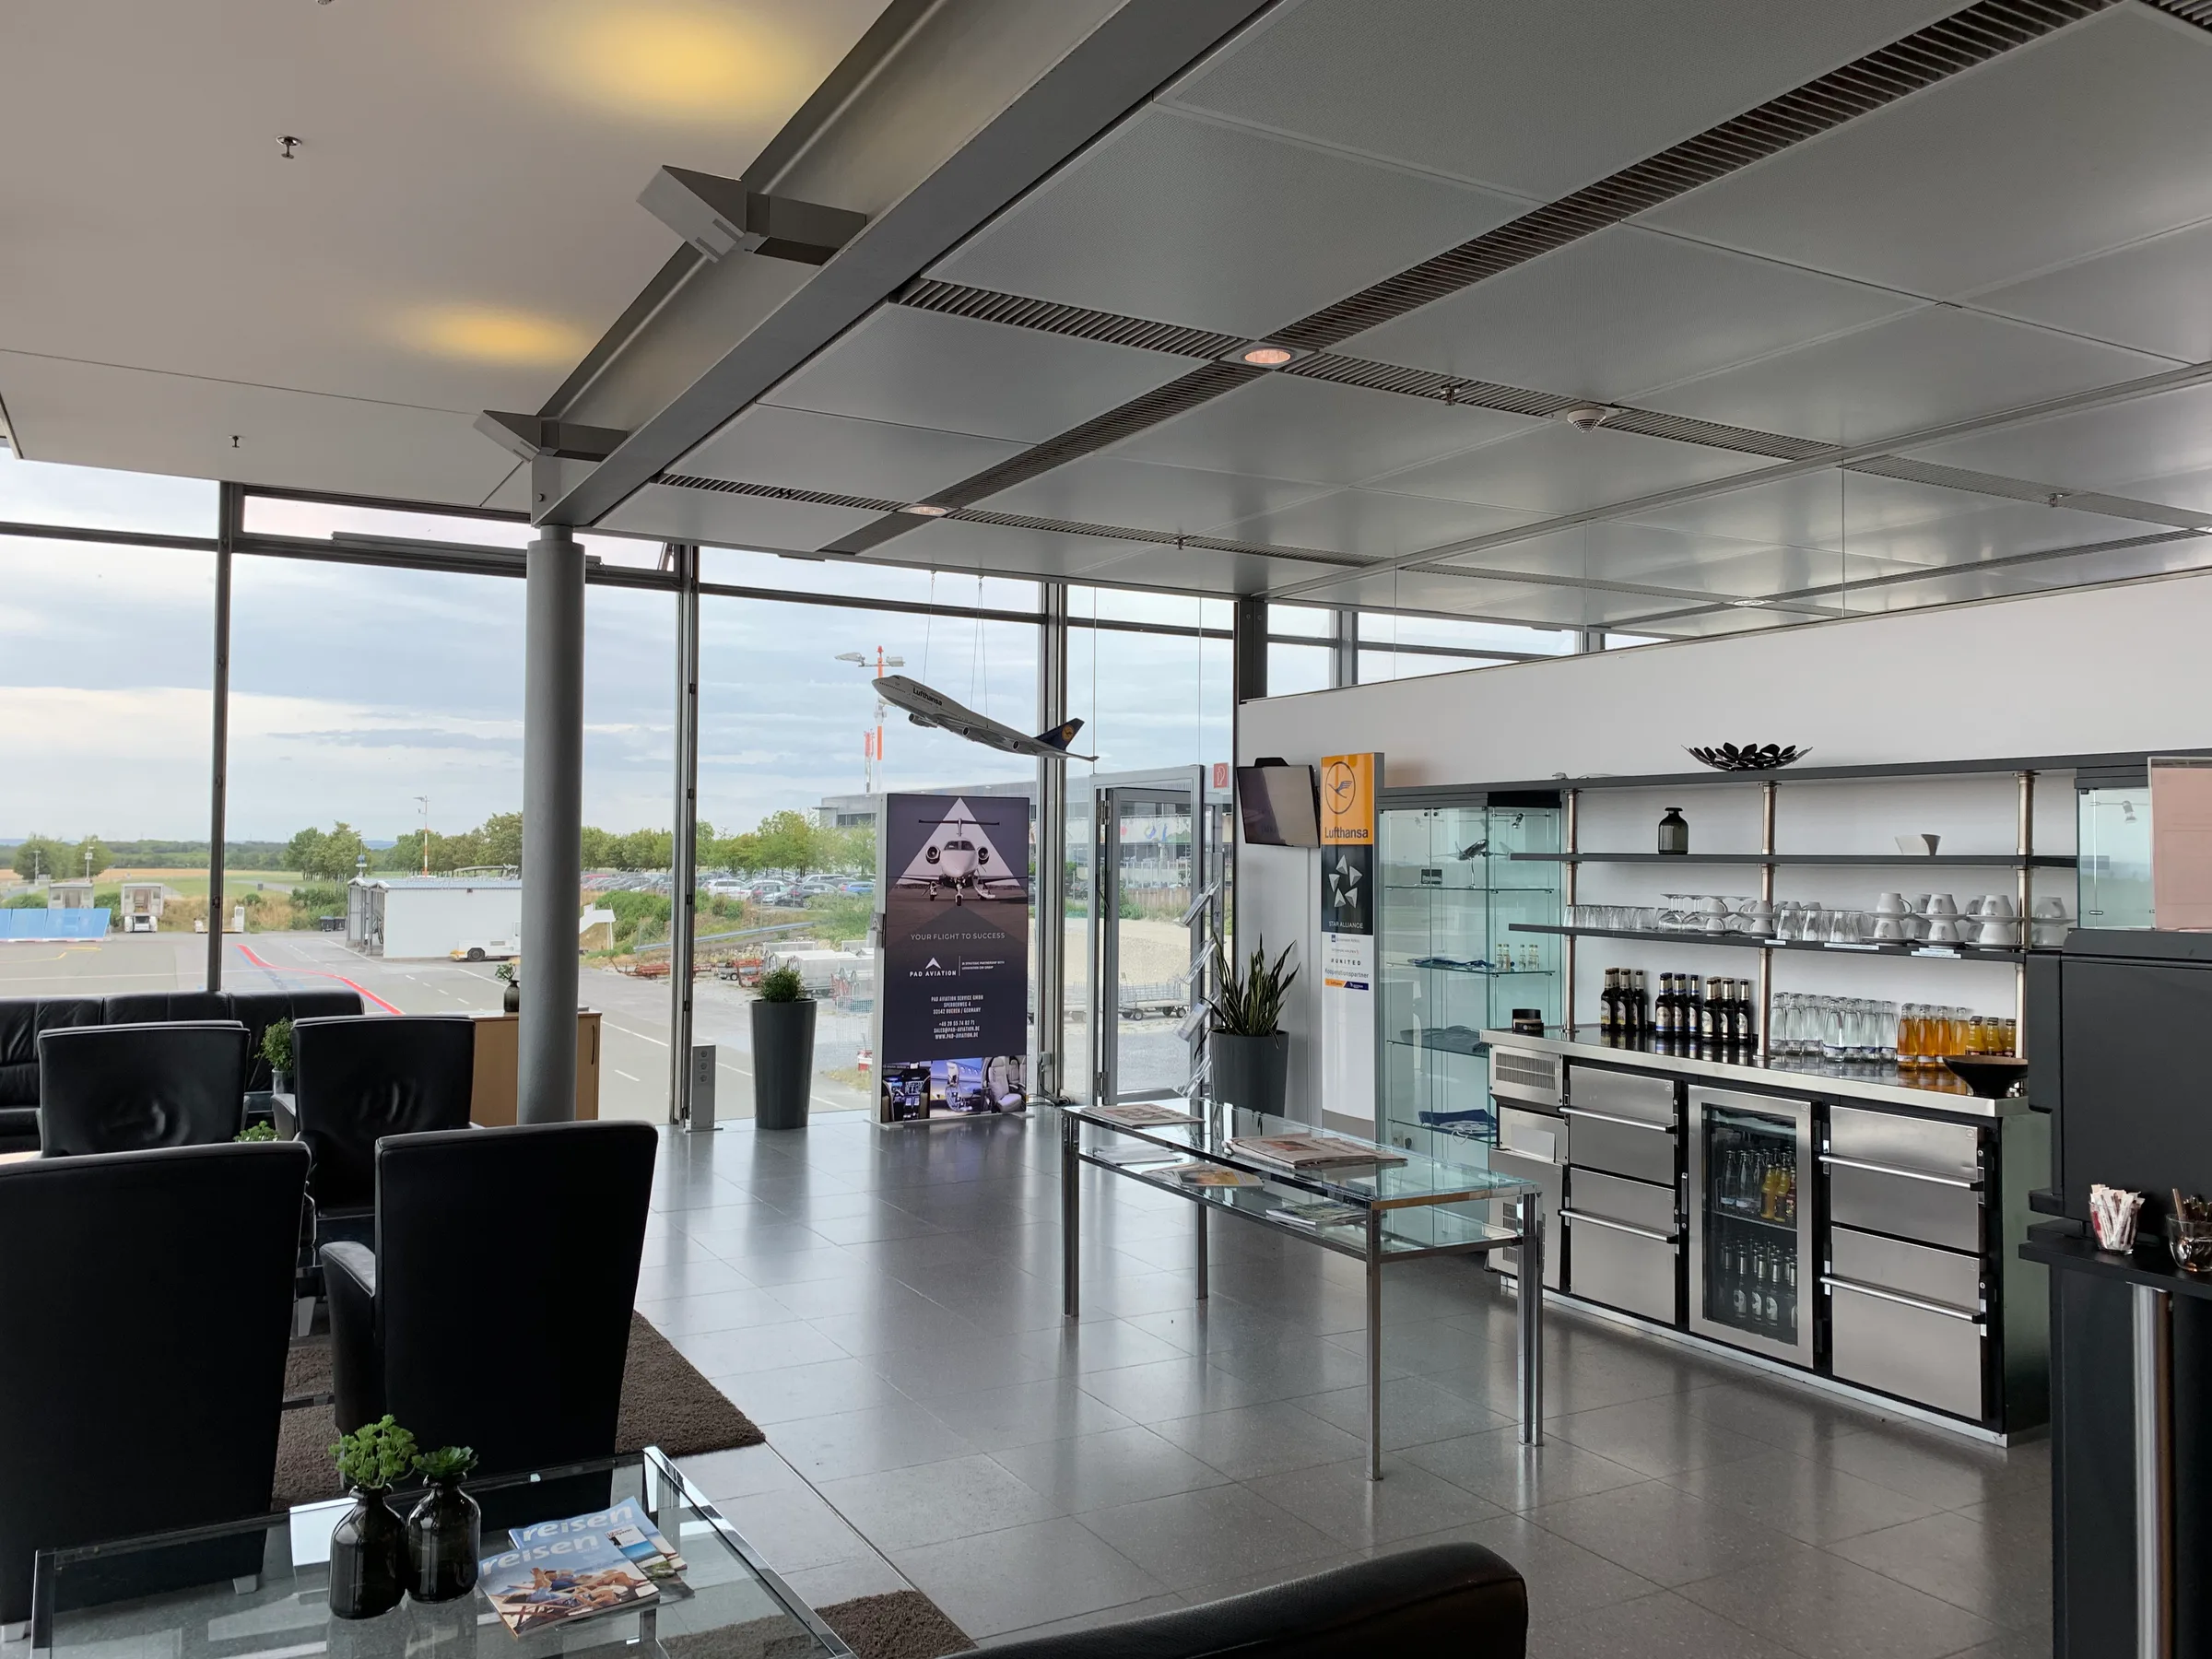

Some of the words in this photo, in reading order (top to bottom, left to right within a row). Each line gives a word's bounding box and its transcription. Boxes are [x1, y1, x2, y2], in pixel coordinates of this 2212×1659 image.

[912, 687, 942, 706] Lufthansa
[1324, 826, 1369, 839] Lufthansa
[523, 1506, 633, 1542] reisen
[482, 1535, 598, 1576] reisen
